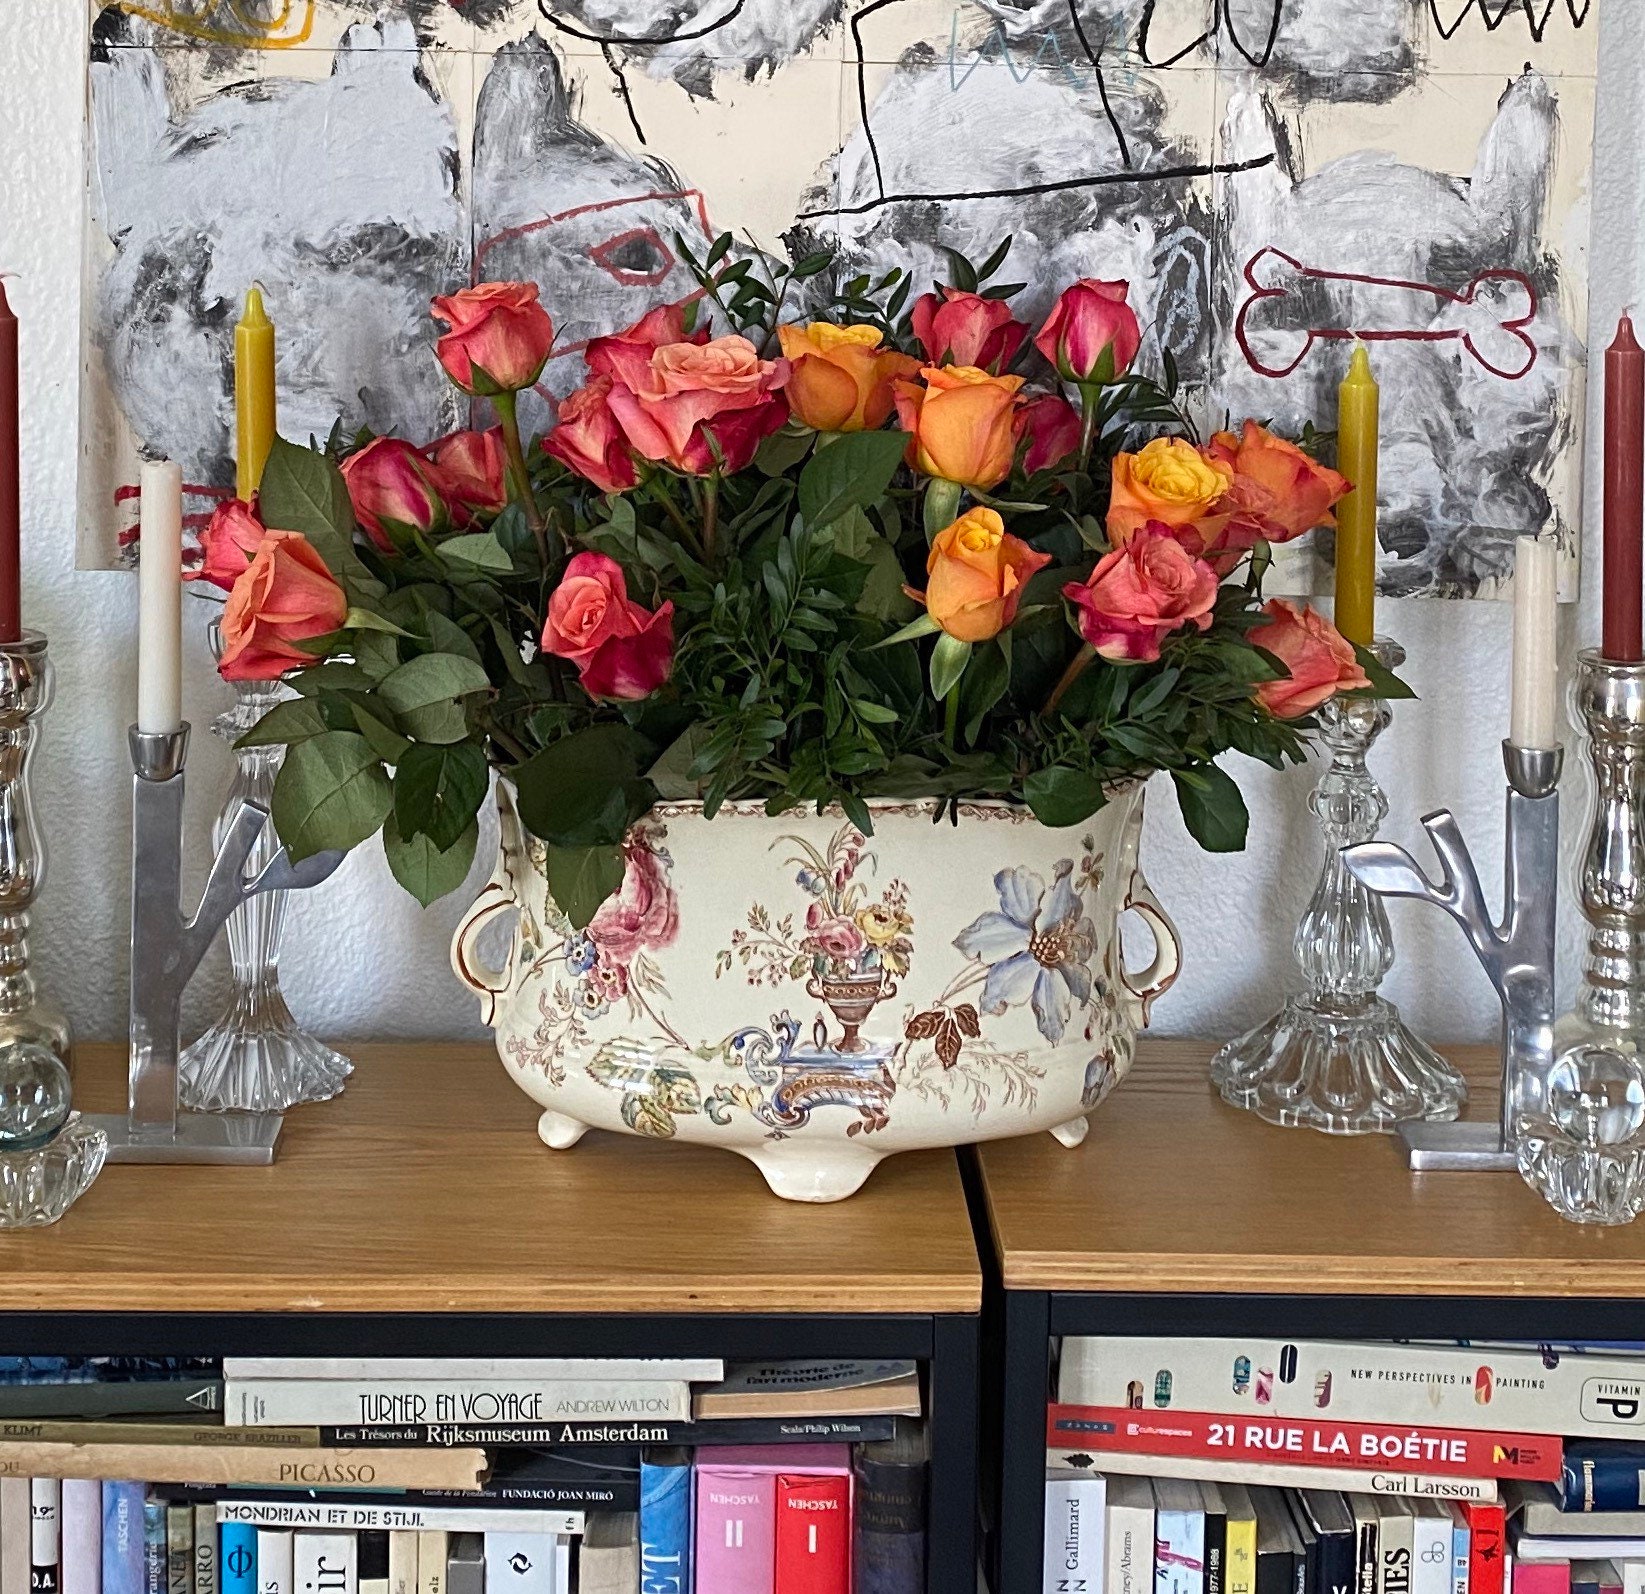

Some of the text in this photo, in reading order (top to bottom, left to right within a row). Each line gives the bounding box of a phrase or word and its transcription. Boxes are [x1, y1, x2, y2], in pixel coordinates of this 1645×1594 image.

[1351, 1369, 1545, 1389] NEW PERSPECTIVES IN PAINTING
[1598, 1384, 1640, 1396] VITAMIN
[359, 1393, 543, 1425] TURNER EN VOYAGE
[556, 1398, 669, 1414] ANDREW WILTON
[1596, 1397, 1639, 1419] P
[4, 1424, 43, 1436] KLIMT
[335, 1424, 669, 1447] Les Trésors du Rijksmuseum Amsterdam
[1206, 1424, 1235, 1447] 21
[1244, 1426, 1303, 1451] RUE
[1313, 1430, 1351, 1455] LA
[1360, 1431, 1468, 1462] BOÉTIE
[279, 1464, 376, 1483] PICASSO
[502, 1488, 614, 1501] FUNDACIÓ JOAN MIRÓ
[1371, 1474, 1480, 1498] Carl Larsson
[709, 1492, 760, 1506] TASCHEN
[788, 1497, 838, 1511] TASCHEN
[118, 1497, 129, 1553] TASCHEN
[225, 1506, 320, 1523] MONDRIAN
[327, 1509, 348, 1524] ET
[353, 1510, 378, 1525] DE
[1065, 1498, 1080, 1570] Gallimard
